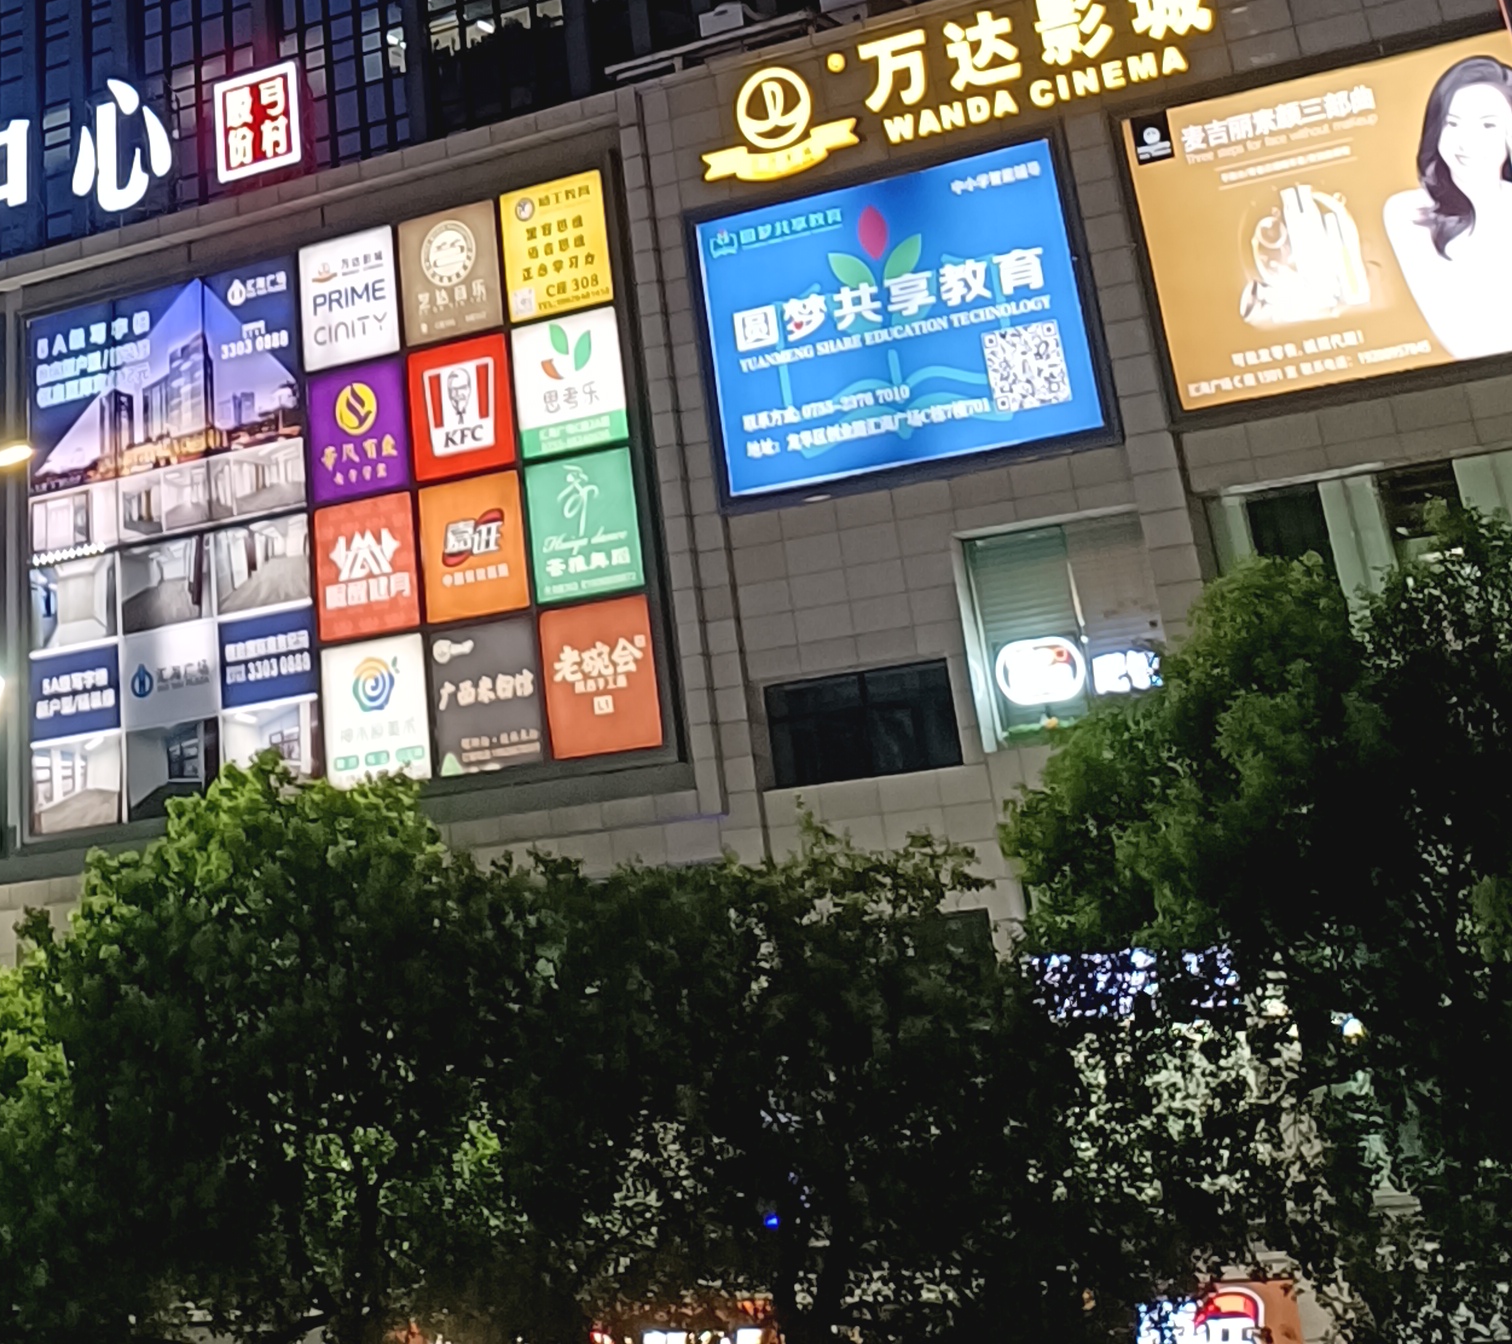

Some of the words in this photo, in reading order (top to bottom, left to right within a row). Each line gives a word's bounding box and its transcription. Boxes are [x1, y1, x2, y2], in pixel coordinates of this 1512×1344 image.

[884, 89, 1018, 144] WANDA
[1029, 46, 1189, 108] CINEMA
[313, 278, 386, 317] PRIME
[572, 273, 599, 292] 308
[733, 247, 1044, 352] 圆梦共享教育
[816, 334, 862, 358] SHARE
[864, 317, 948, 345] EDUCATION
[950, 294, 1052, 328] TECHNOLOGY
[221, 336, 253, 360] 3303
[543, 381, 600, 413] 思考乐
[444, 424, 484, 448] KFC
[247, 658, 278, 681] 3303
[553, 637, 644, 682] 老碗会
